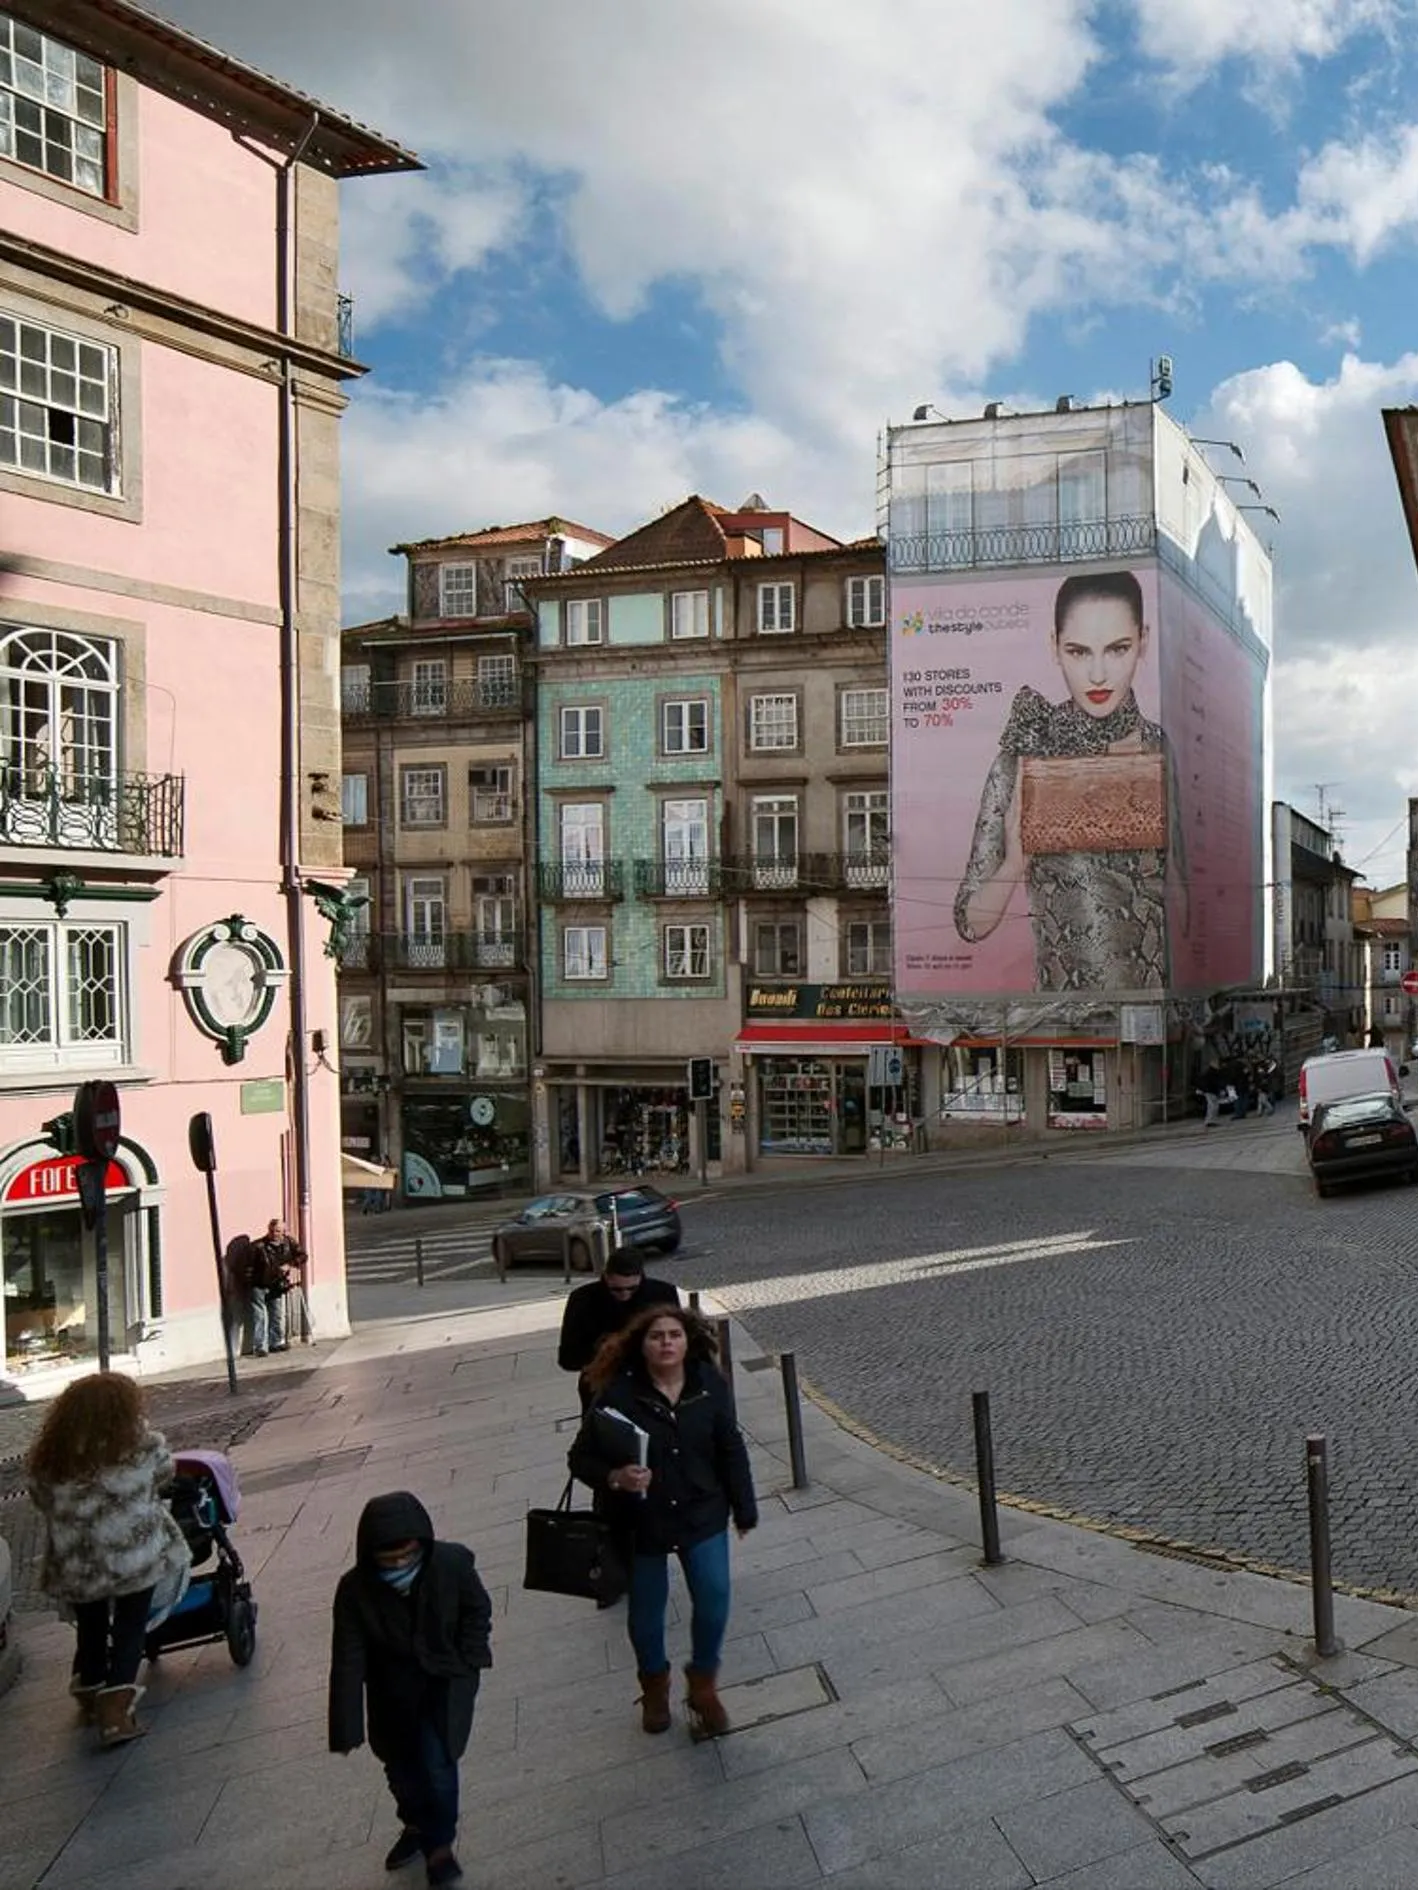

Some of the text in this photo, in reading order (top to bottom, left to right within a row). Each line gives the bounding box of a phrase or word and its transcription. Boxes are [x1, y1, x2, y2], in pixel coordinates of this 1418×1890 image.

[924, 668, 970, 681] STORES
[903, 682, 1003, 697] WITH DISCOUNTS
[903, 696, 974, 712] FROM 30%
[903, 713, 953, 728] TO 70%
